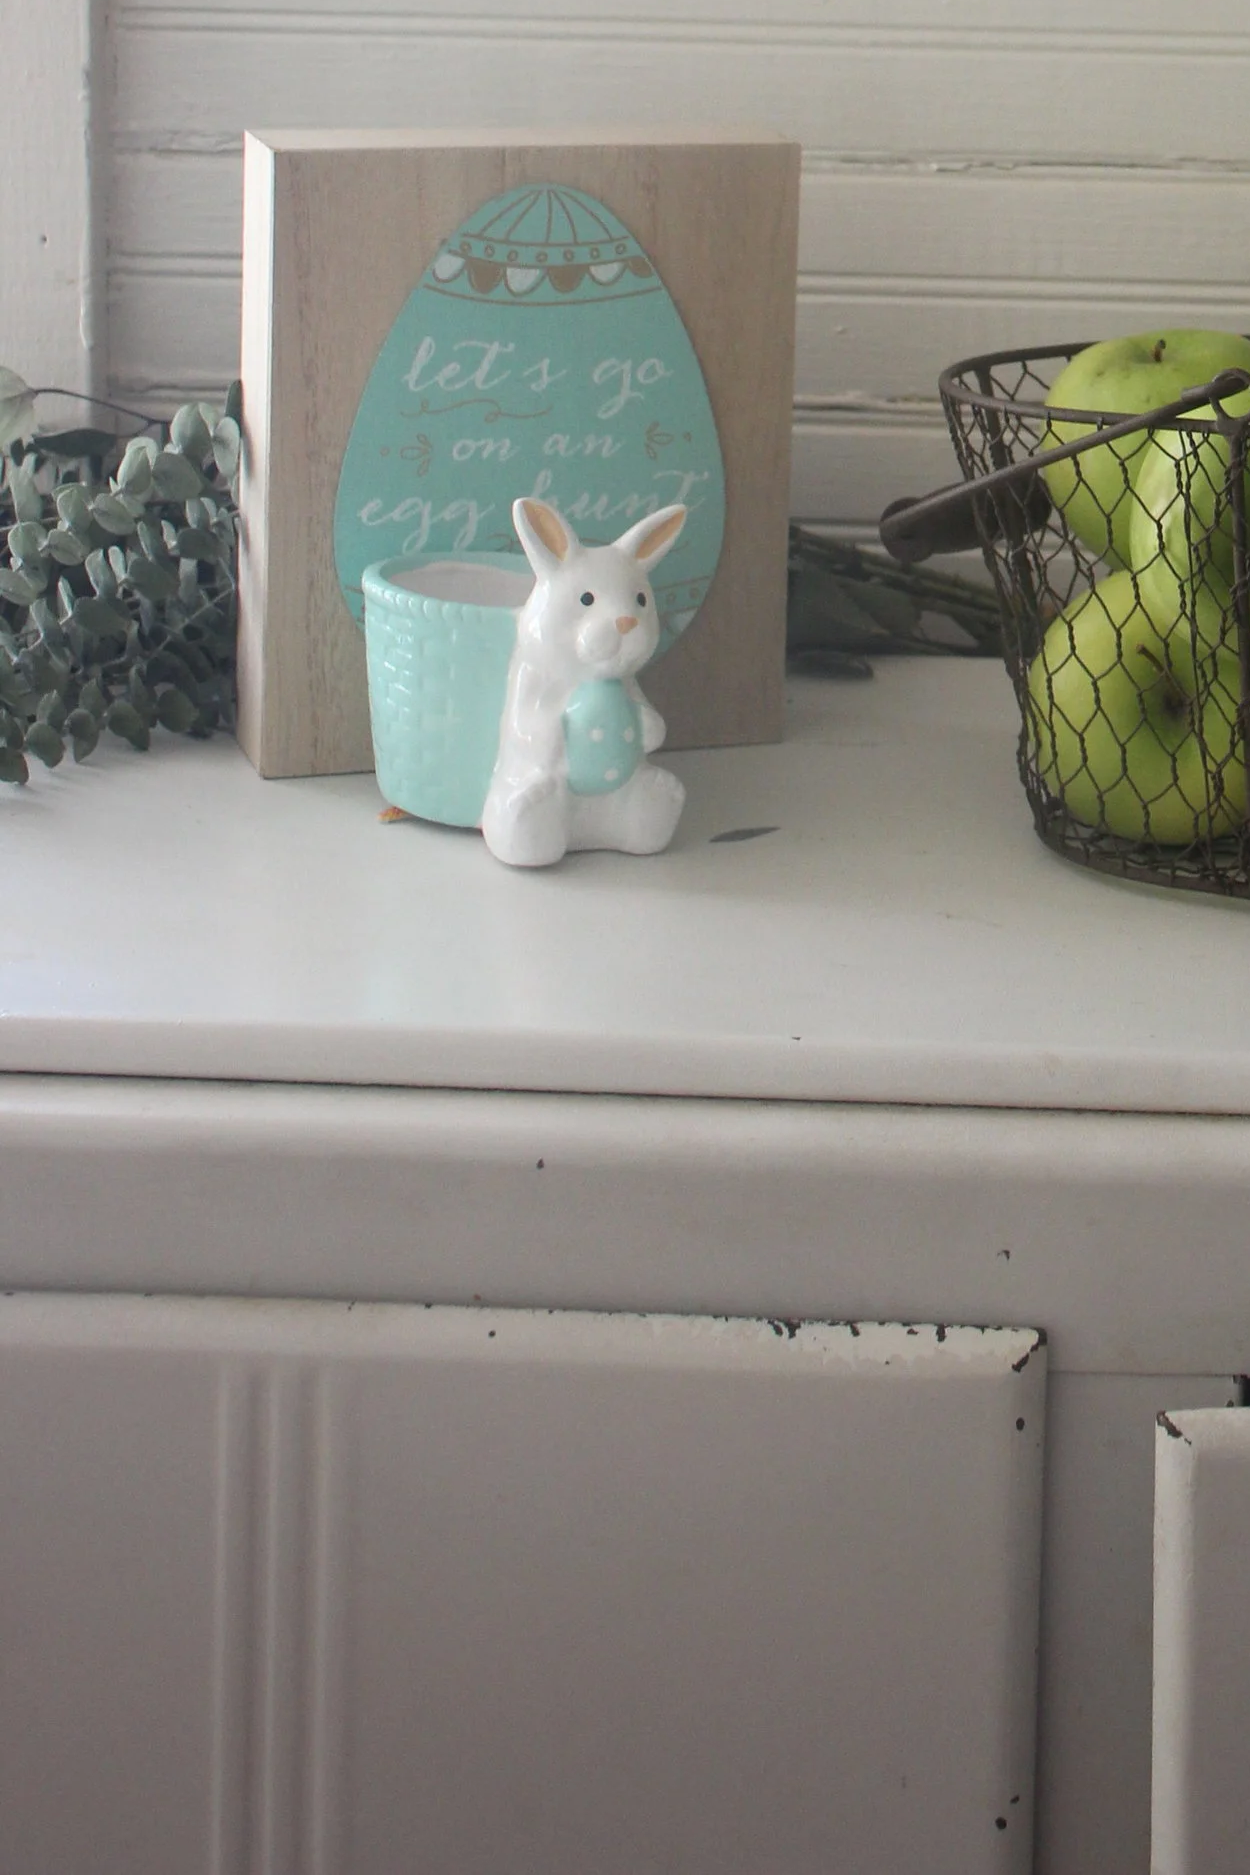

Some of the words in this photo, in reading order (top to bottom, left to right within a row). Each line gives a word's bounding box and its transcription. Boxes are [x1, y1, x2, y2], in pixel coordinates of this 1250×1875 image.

[592, 357, 673, 419] go
[452, 438, 520, 461] on
[543, 433, 625, 458] an
[357, 496, 495, 556] egg
